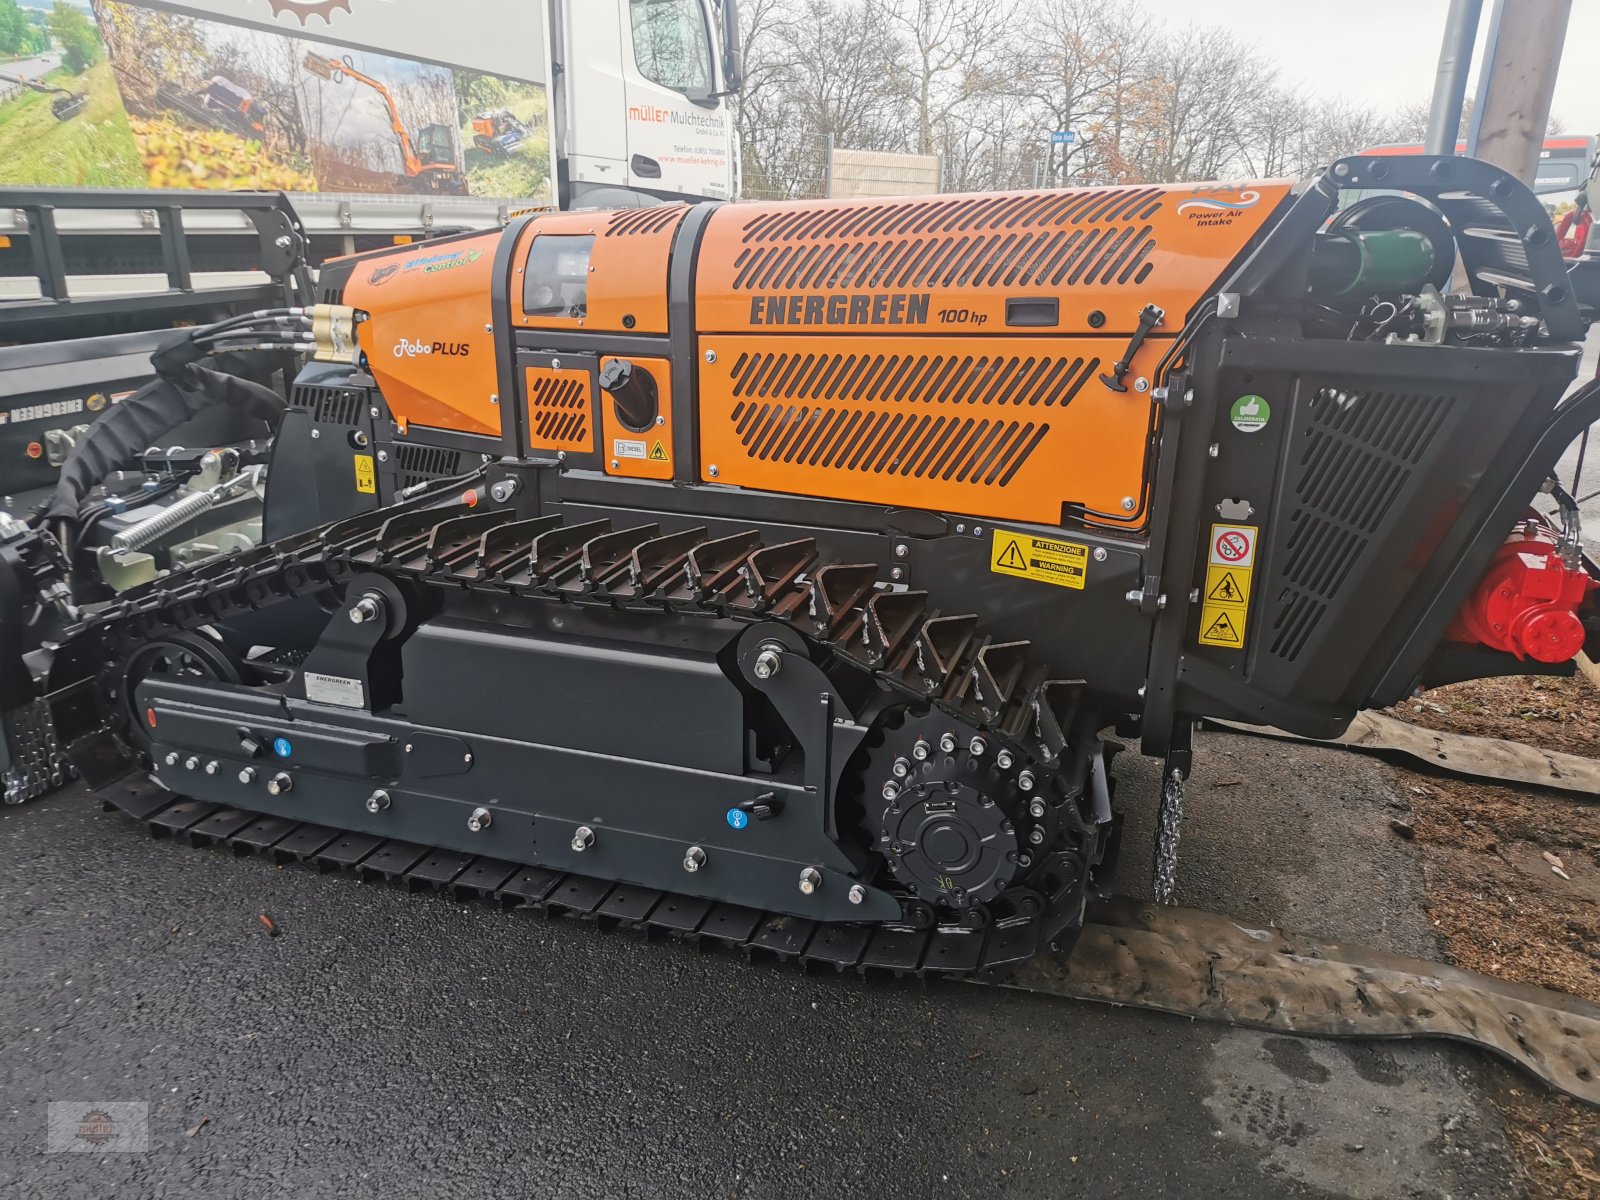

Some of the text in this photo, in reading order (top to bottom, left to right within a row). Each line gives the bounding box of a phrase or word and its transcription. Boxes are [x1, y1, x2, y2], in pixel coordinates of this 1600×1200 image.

[629, 105, 725, 129] müller Mulchtechnik
[1189, 212, 1223, 220] Power
[1197, 219, 1233, 227] Intake
[750, 294, 988, 326] ENERGREEN 100 hp
[626, 445, 642, 453] DIESEL
[1035, 541, 1082, 555] ATTENZIONE
[1039, 561, 1074, 574] WARNING
[316, 676, 351, 685] ENERGREEN
